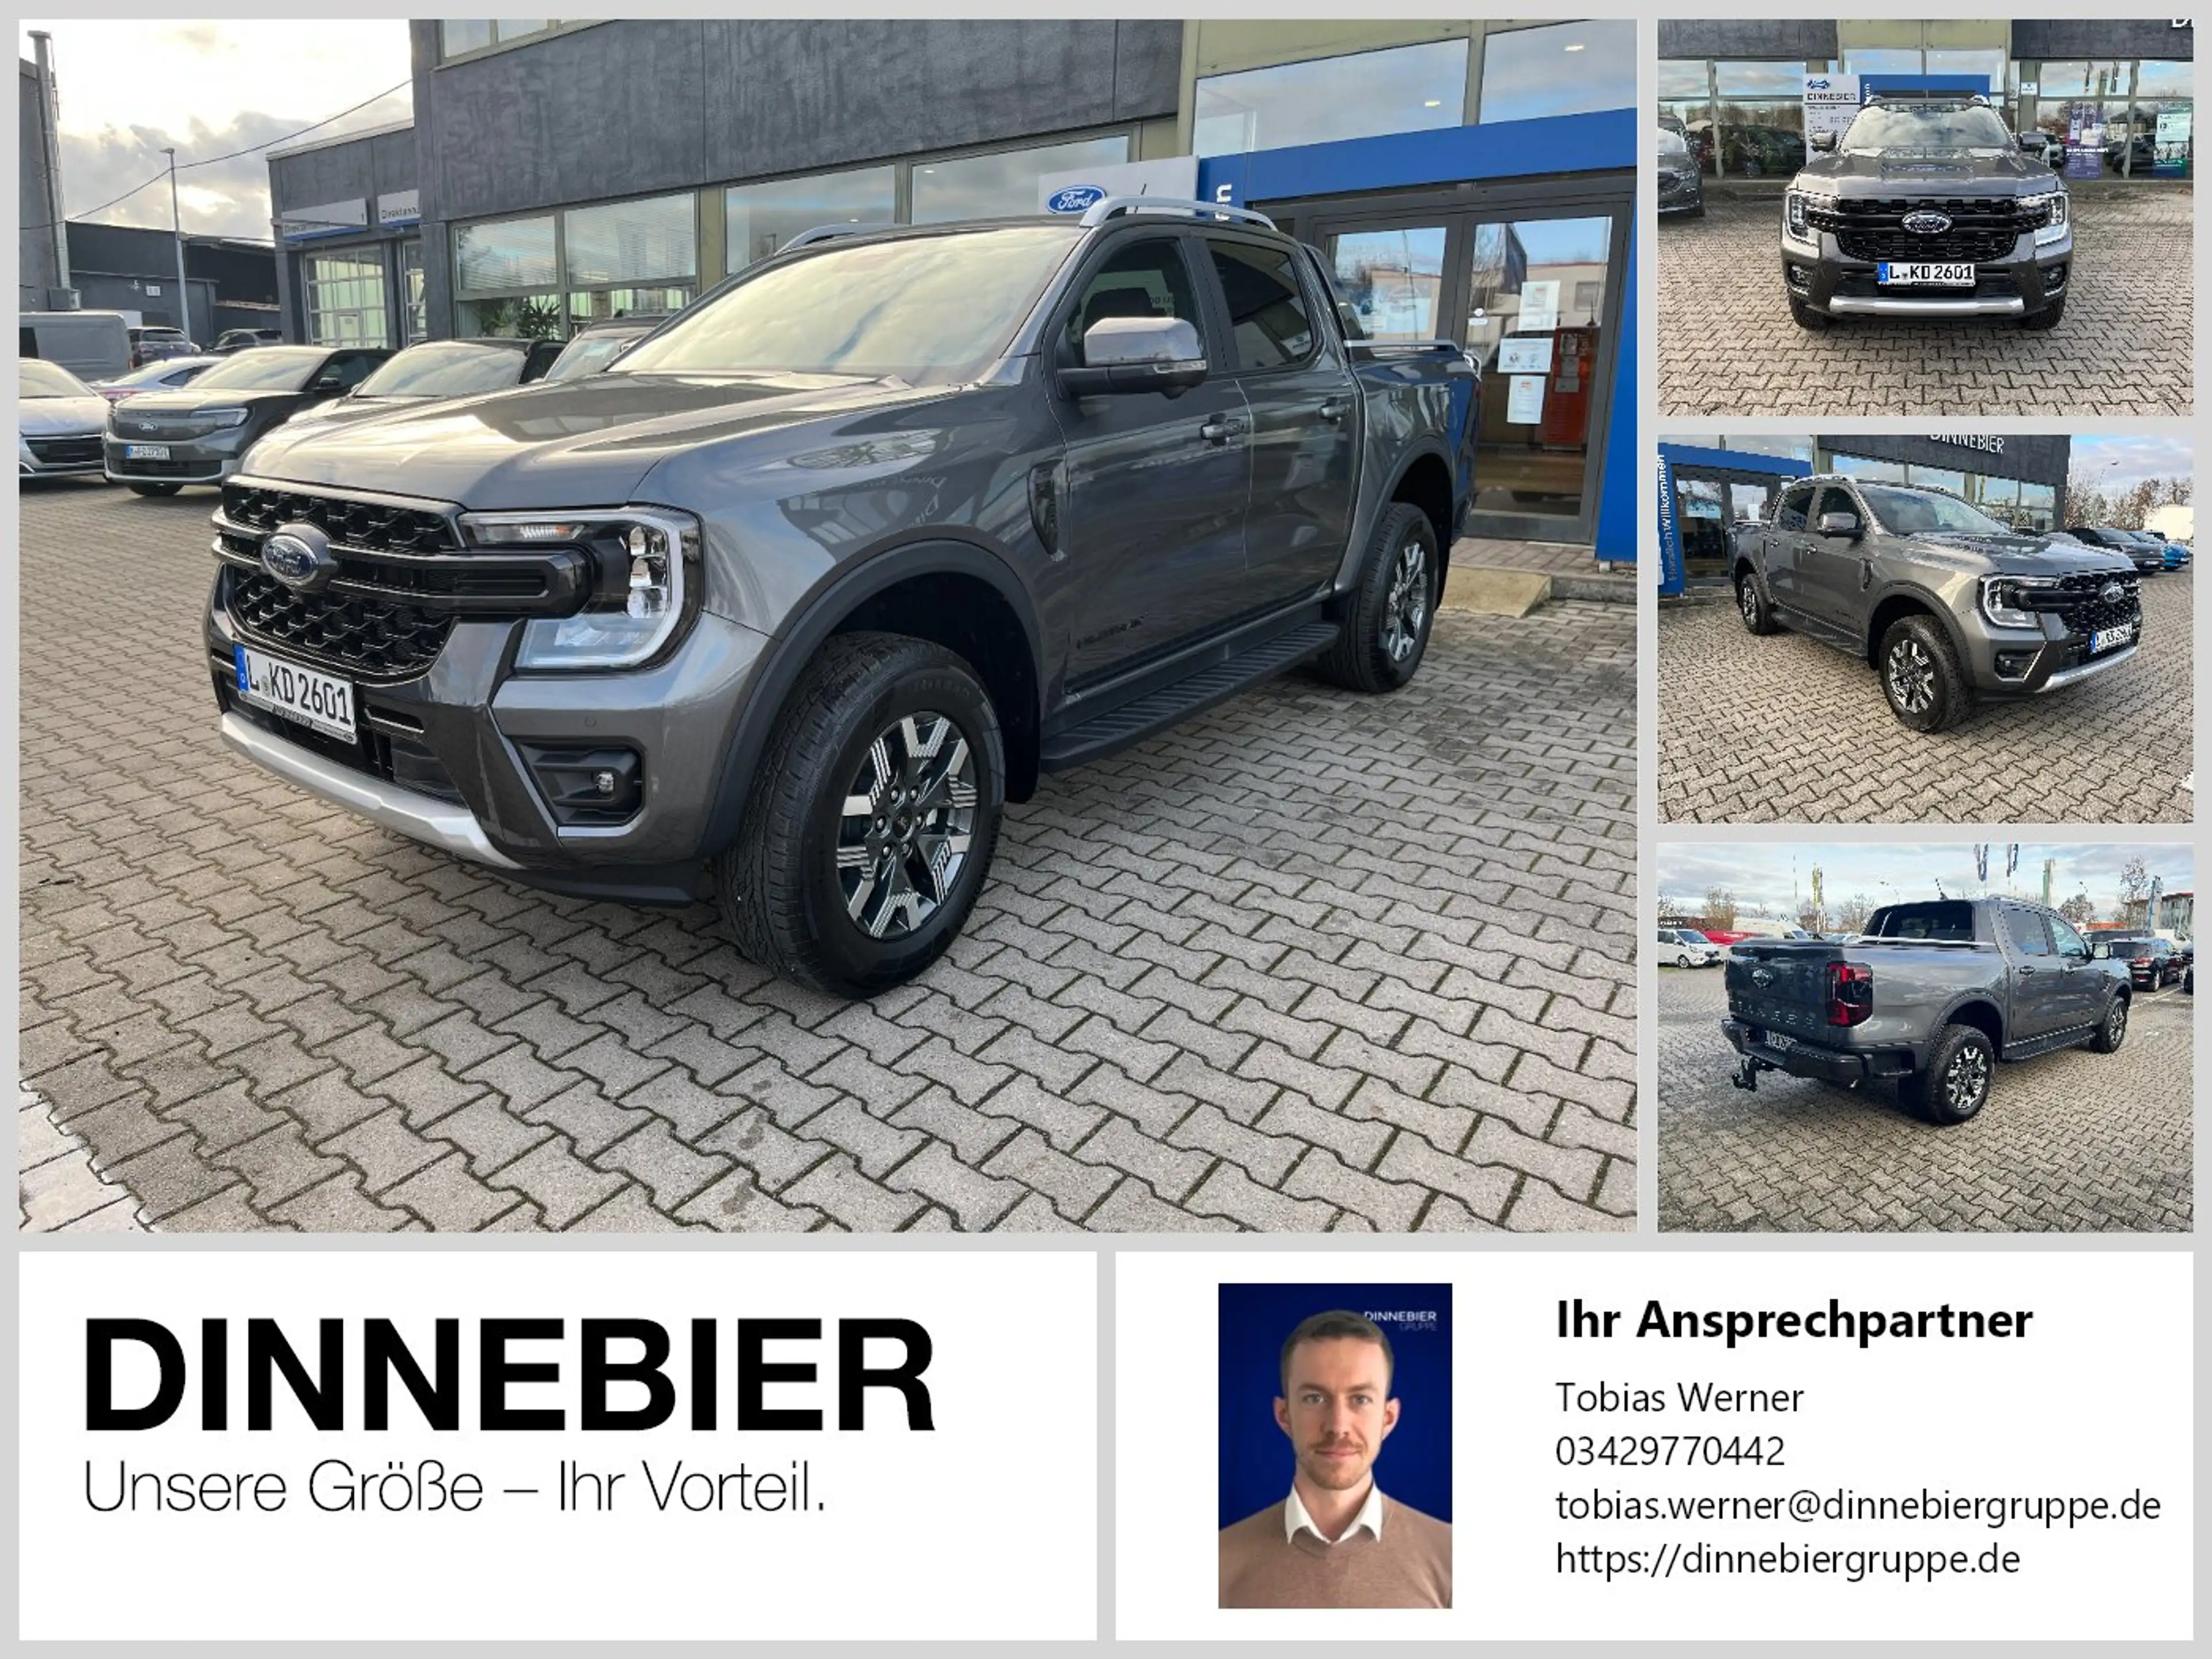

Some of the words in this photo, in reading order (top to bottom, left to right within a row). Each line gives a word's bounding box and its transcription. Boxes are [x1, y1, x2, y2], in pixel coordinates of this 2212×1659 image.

[1889, 265, 1900, 279] L
[1910, 265, 1930, 279] KD
[1934, 265, 1973, 279] 2601
[246, 654, 260, 691] L
[268, 662, 295, 704] KD
[298, 673, 351, 726] 2601
[1363, 1310, 1437, 1322] DINNEBIER
